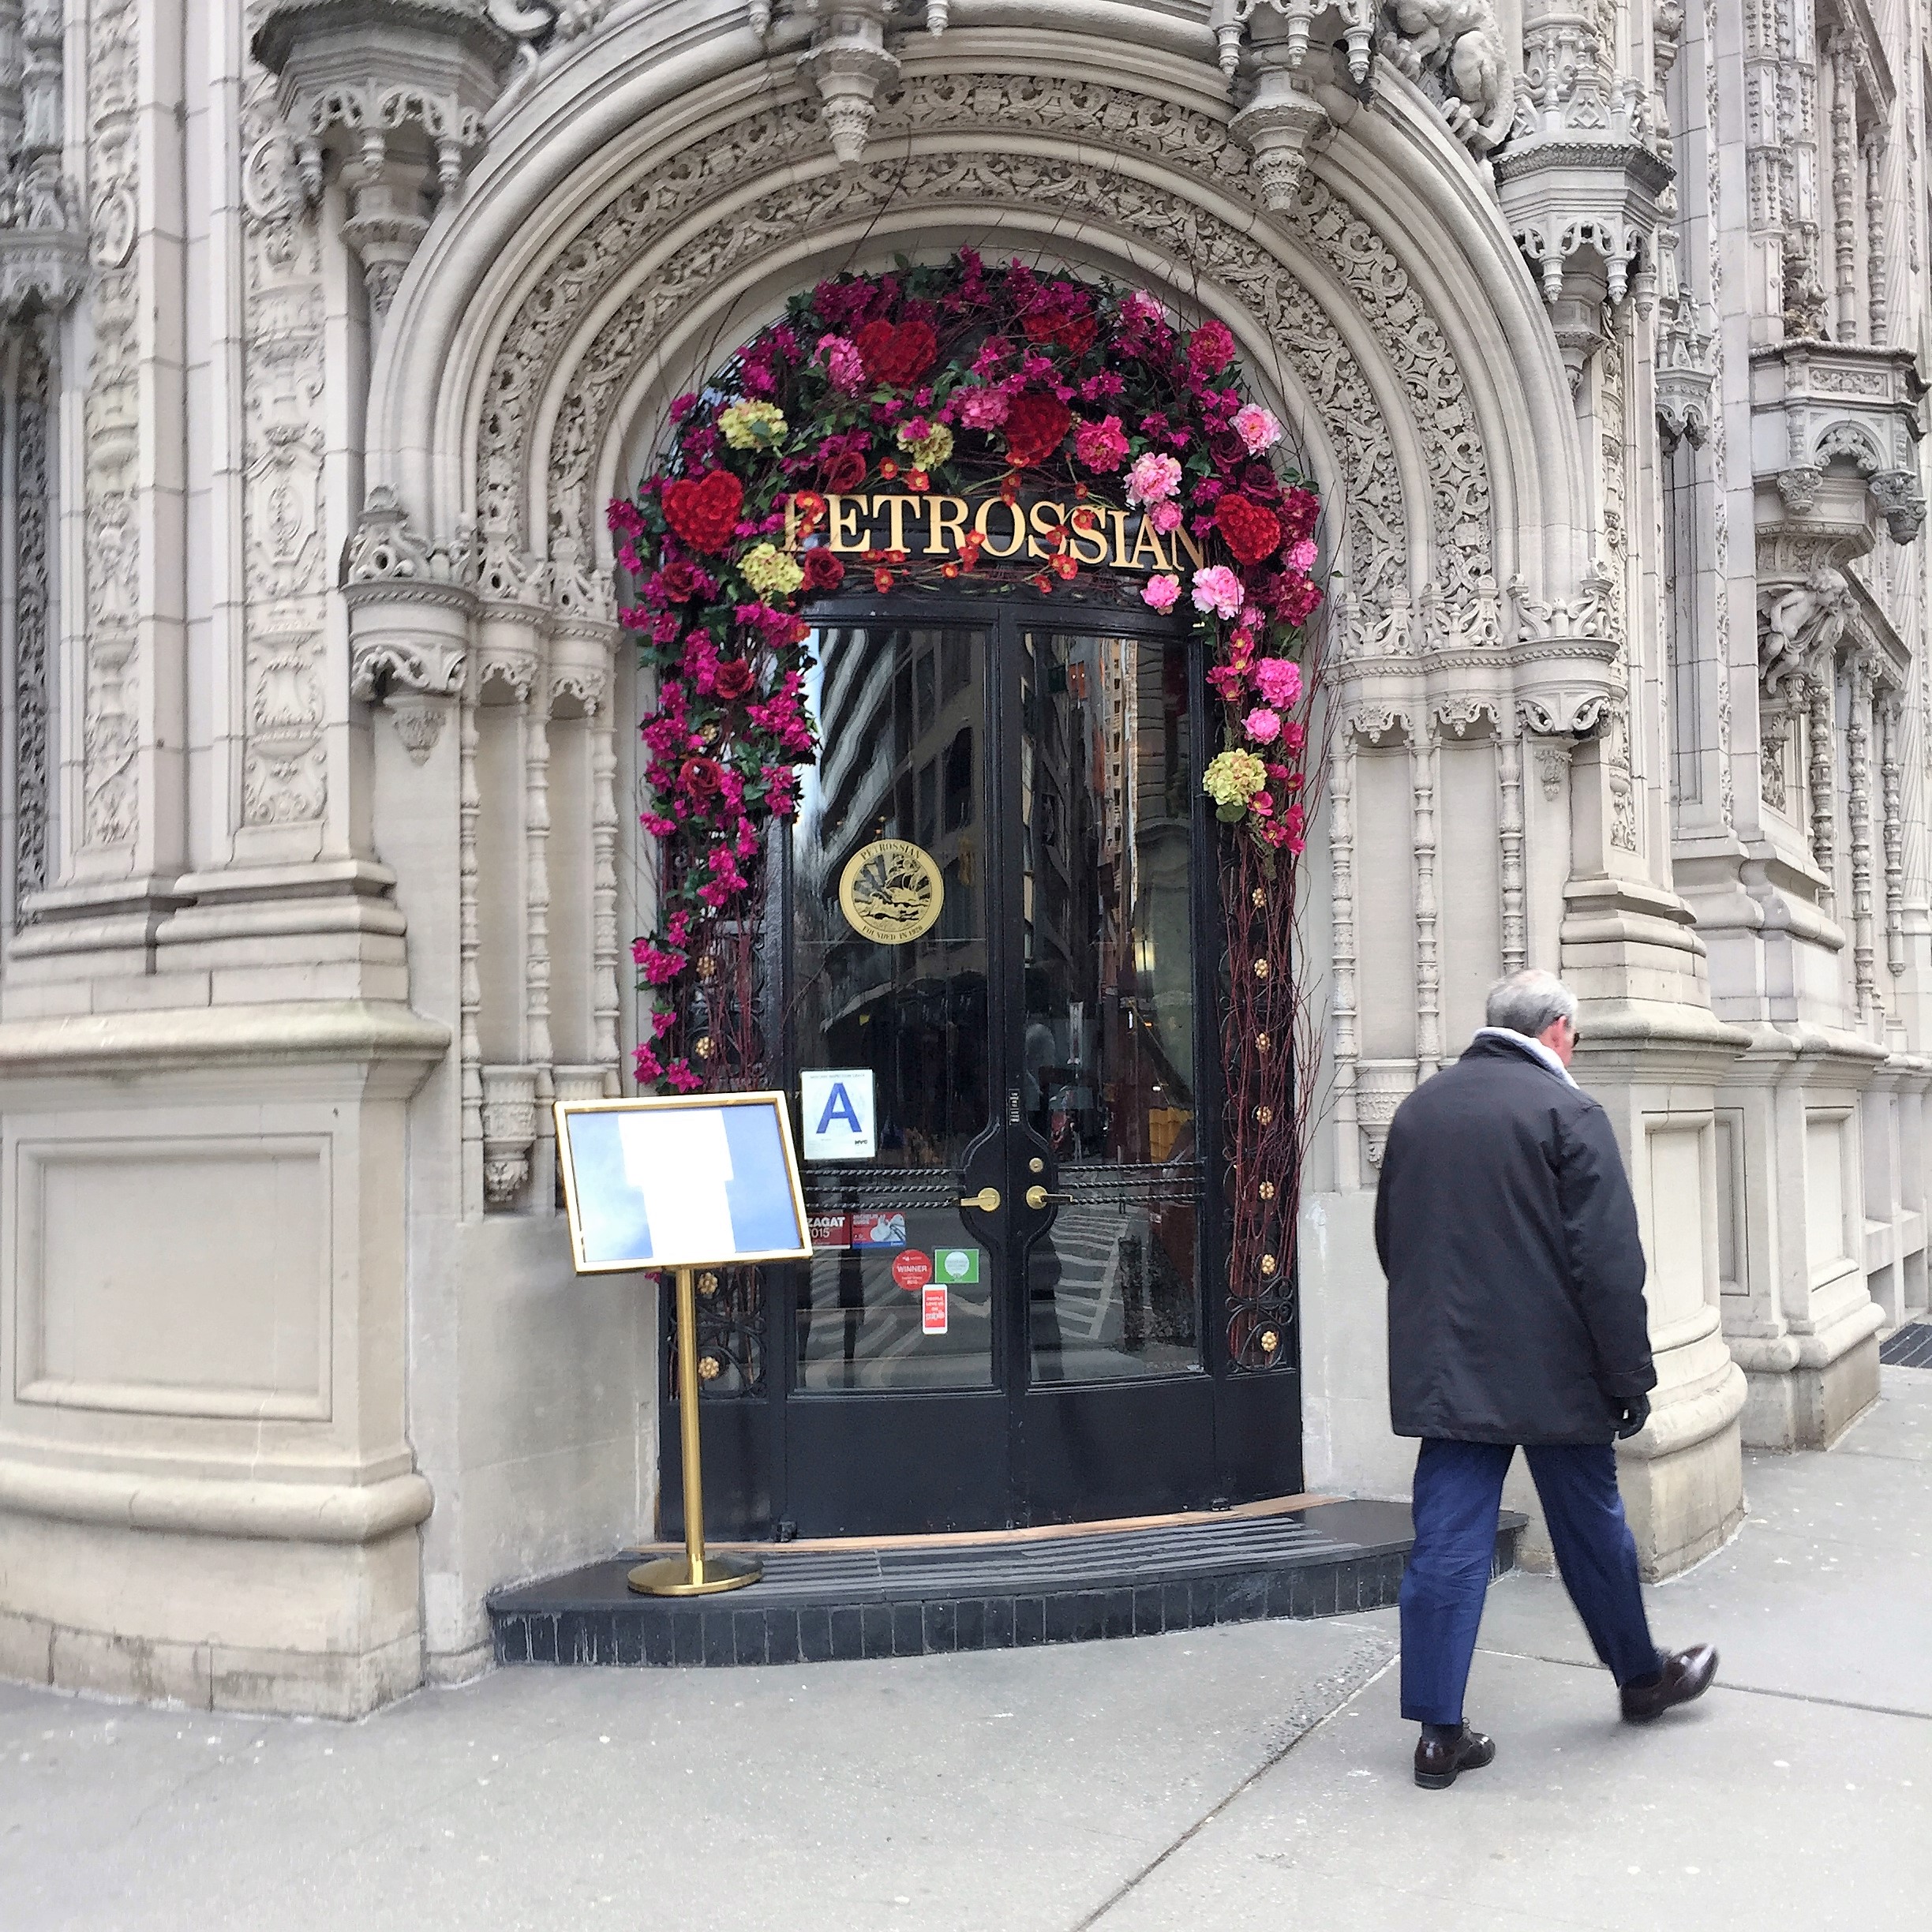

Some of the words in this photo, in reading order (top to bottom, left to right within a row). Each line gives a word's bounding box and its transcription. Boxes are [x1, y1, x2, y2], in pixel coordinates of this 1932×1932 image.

[860, 844, 921, 859] PETROSSIAN
[862, 926, 896, 940] FOUNDED
[816, 1082, 862, 1134] A
[807, 1216, 845, 1228] ZAGAT
[810, 1227, 830, 1238] 015
